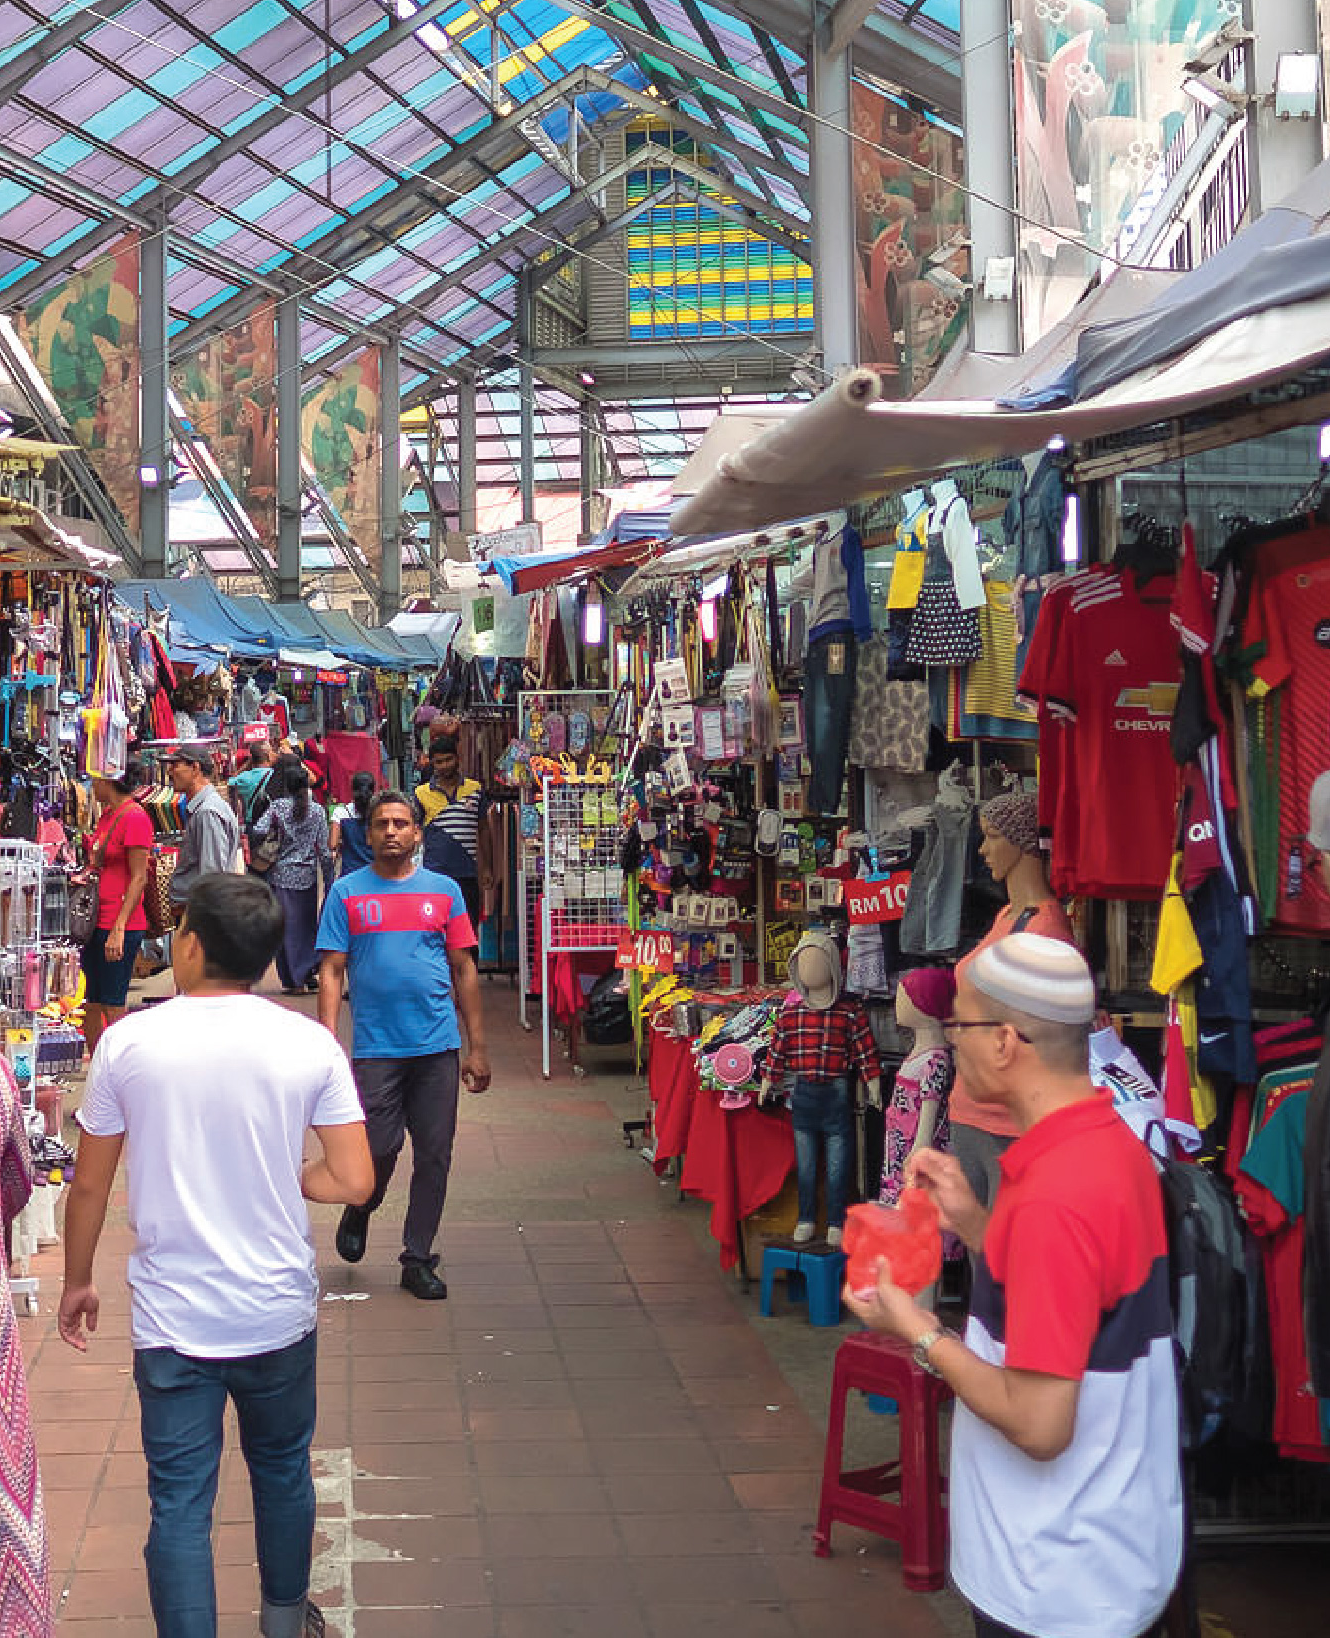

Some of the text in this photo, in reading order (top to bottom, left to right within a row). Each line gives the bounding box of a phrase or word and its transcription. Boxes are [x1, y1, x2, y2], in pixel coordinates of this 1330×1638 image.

[1114, 719, 1171, 732] CHEVR
[355, 898, 383, 927] 10
[849, 883, 909, 916] RM 10
